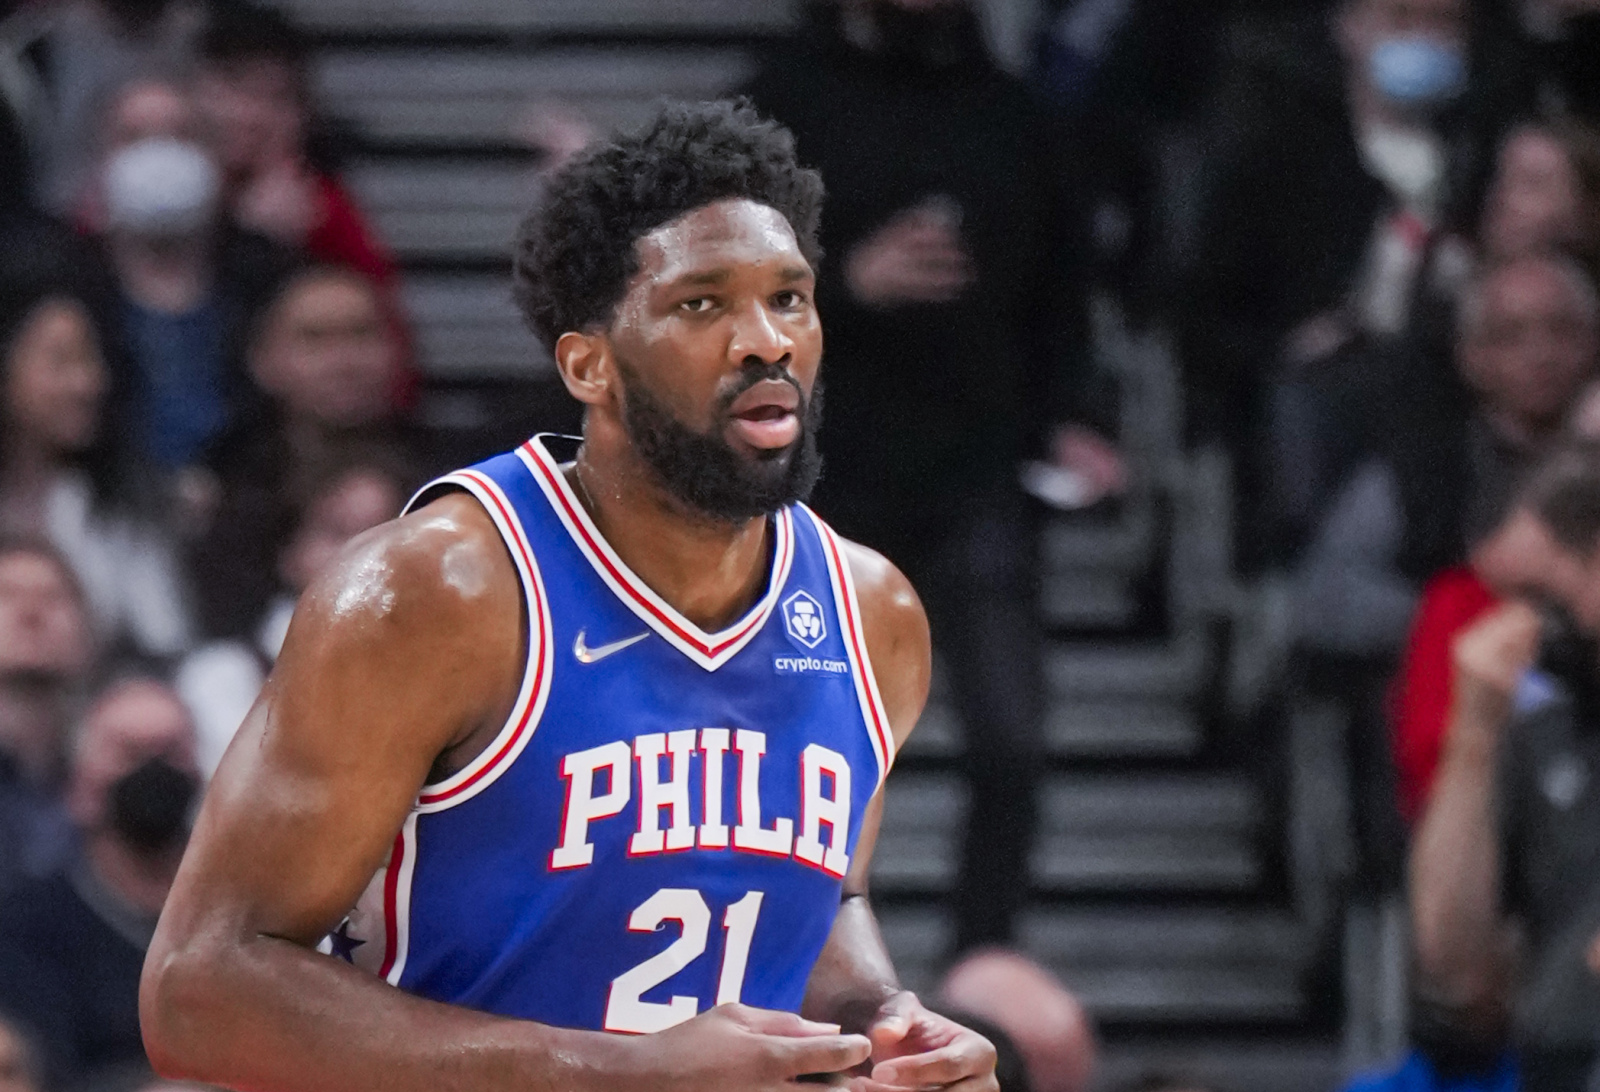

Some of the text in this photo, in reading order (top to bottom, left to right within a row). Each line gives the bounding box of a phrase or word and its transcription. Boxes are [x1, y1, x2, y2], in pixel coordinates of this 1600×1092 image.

[775, 656, 848, 673] crypto.com
[548, 728, 851, 879] PHILA
[604, 888, 764, 1034] 21
